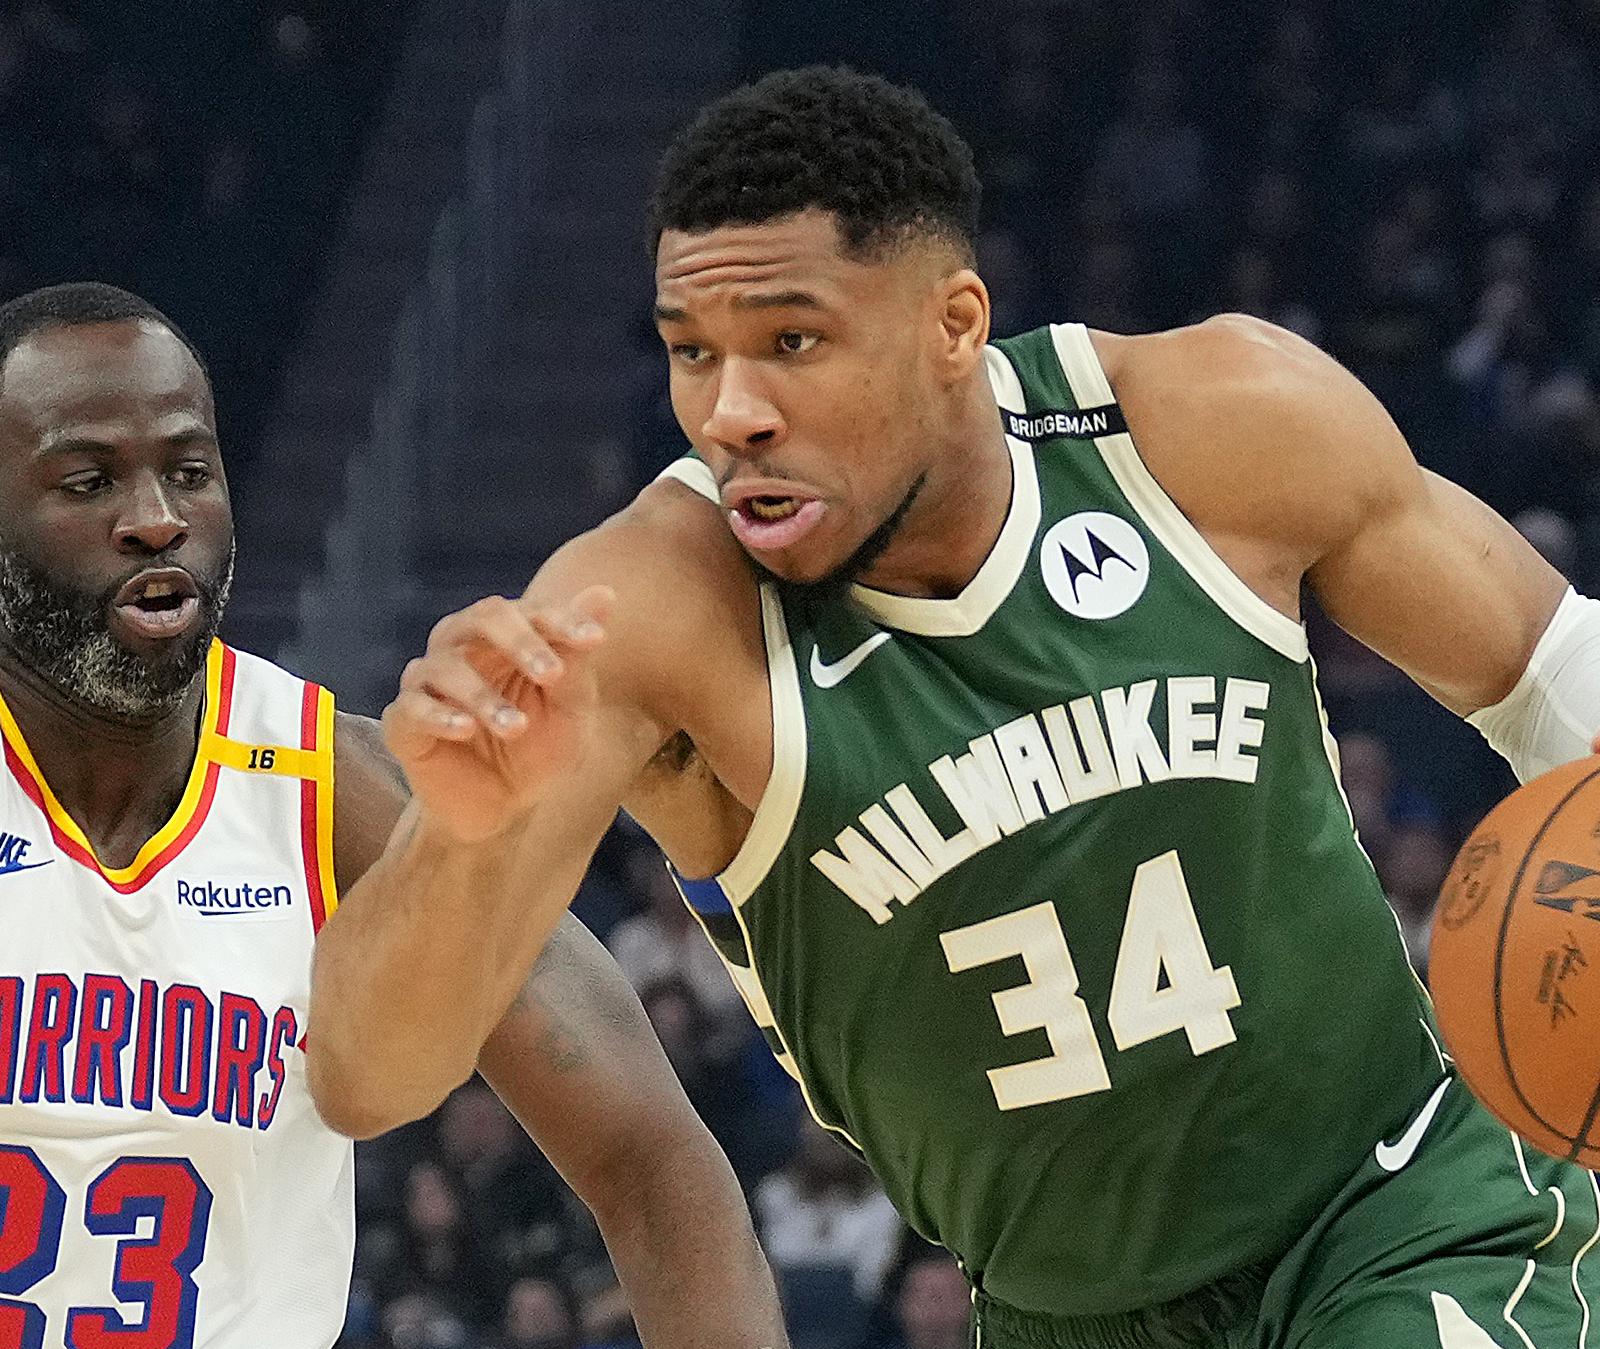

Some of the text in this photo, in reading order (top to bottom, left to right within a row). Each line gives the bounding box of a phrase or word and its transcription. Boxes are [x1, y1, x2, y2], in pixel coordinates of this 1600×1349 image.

[1009, 411, 1108, 438] BRIDGEMAN
[248, 749, 286, 769] 16
[809, 676, 1270, 925] MILWAUKEE
[177, 879, 292, 908] Rakuten
[938, 850, 1242, 1111] 34
